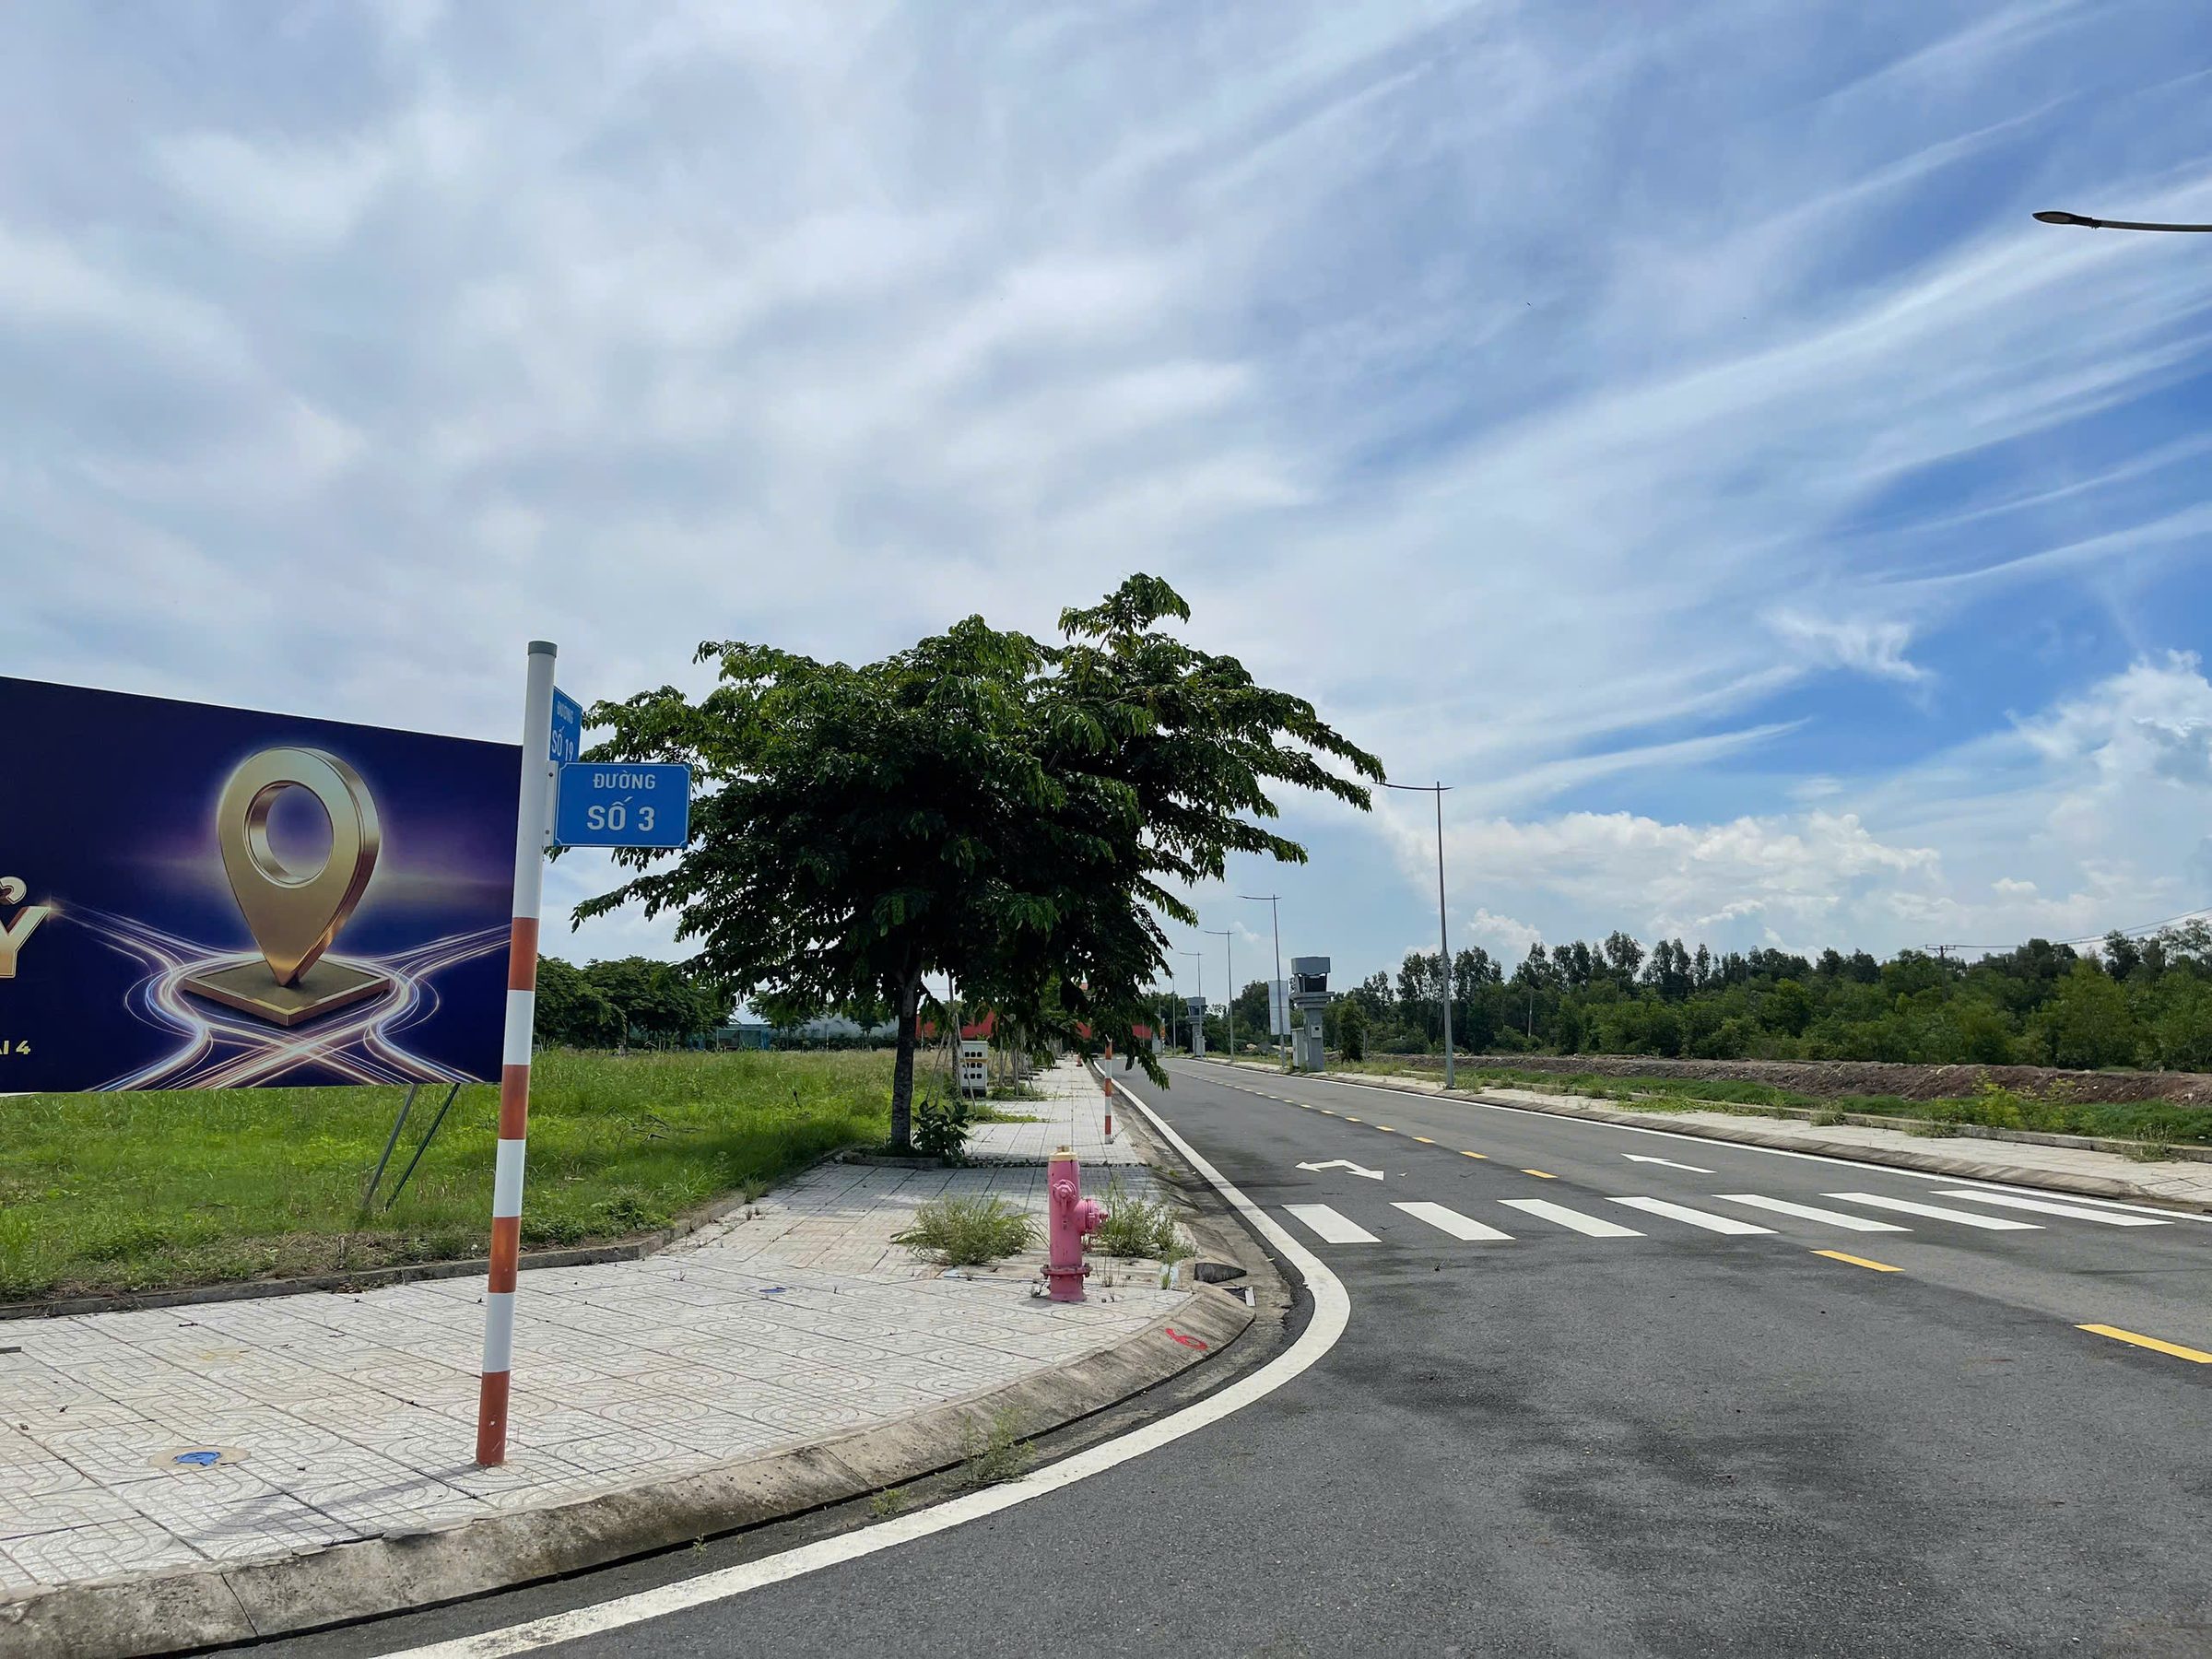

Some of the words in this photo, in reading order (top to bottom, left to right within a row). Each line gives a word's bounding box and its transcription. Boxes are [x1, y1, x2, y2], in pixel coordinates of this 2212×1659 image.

[551, 725, 565, 758] SỐ
[565, 738, 574, 762] 19
[593, 770, 656, 790] ĐƯỜNG
[586, 795, 634, 831] SỐ
[638, 806, 655, 832] 3
[16, 1040, 31, 1055] 4
